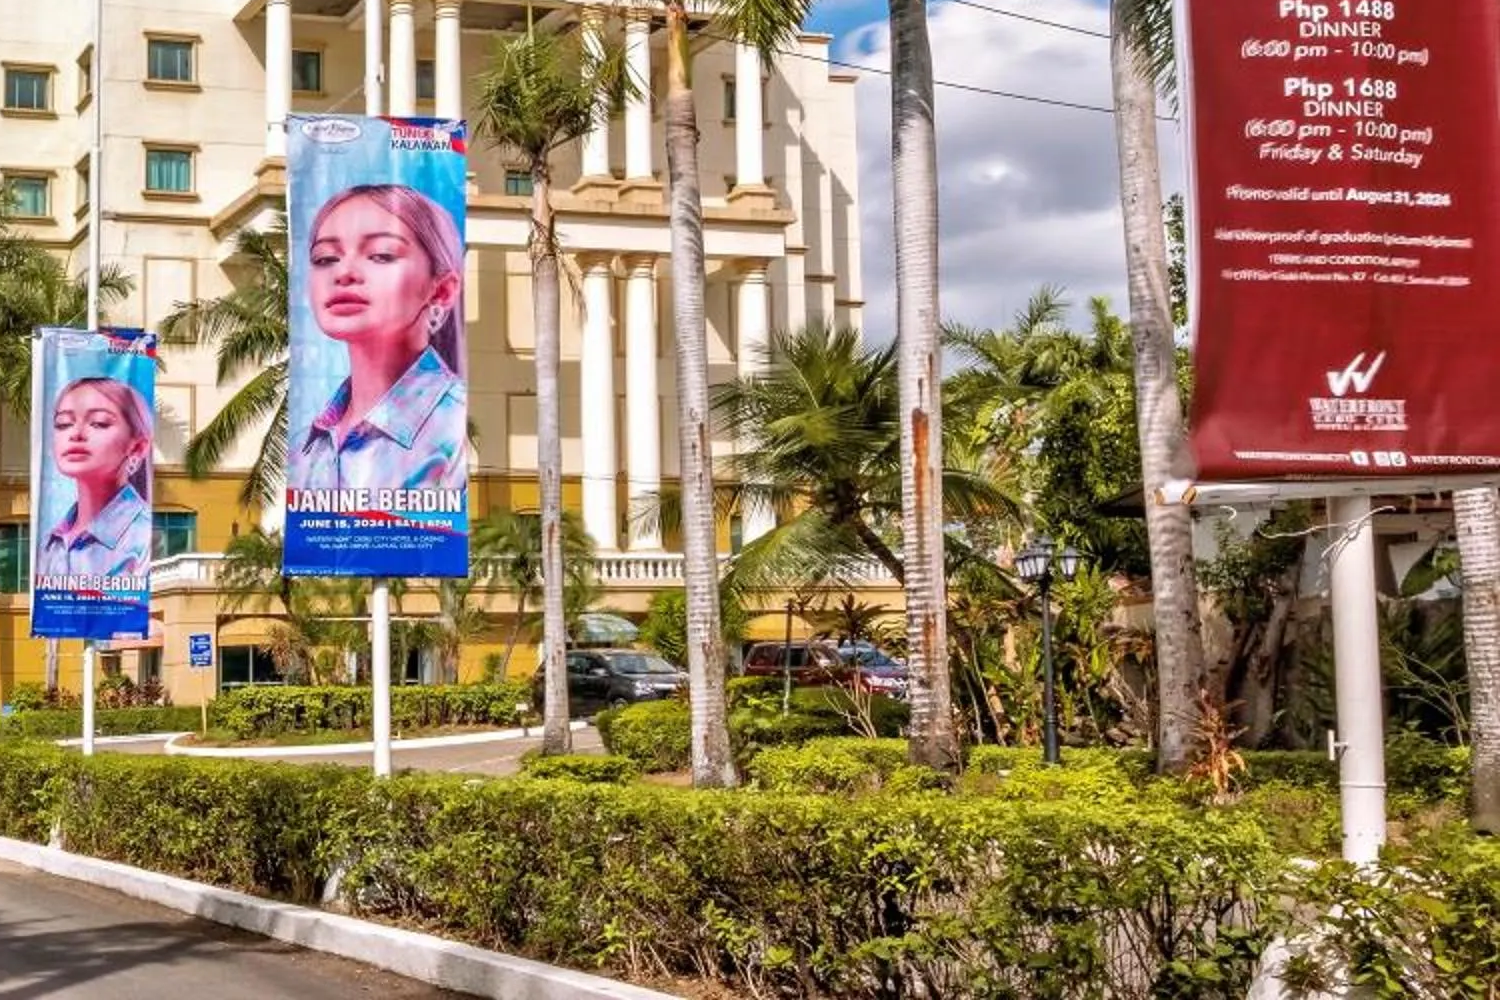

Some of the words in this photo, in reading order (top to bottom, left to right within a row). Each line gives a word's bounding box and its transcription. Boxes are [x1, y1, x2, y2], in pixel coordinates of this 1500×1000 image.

[1279, 0, 1329, 22] Php
[1339, 0, 1395, 21] 1488
[1299, 21, 1382, 38] DINNER
[1241, 39, 1291, 59] (6:00
[1294, 45, 1328, 62] pm
[1350, 42, 1395, 60] 10:00
[1397, 47, 1429, 66] pm)
[1283, 77, 1333, 101] Php
[1343, 77, 1397, 100] 1688
[1303, 100, 1384, 118] DINNER
[1245, 118, 1296, 139] (6:00
[1298, 123, 1332, 141] pm
[1354, 121, 1397, 139] 10:00
[1400, 126, 1433, 145] pm)
[1259, 141, 1323, 165] Friday
[1327, 143, 1344, 161] &
[1351, 143, 1424, 169] Saturday
[1345, 187, 1392, 205] August
[287, 488, 373, 513] JANINE
[379, 488, 462, 513] BERDIN
[299, 519, 332, 529] JUNE
[36, 575, 88, 591] JANINE
[93, 575, 147, 591] BERDIN
